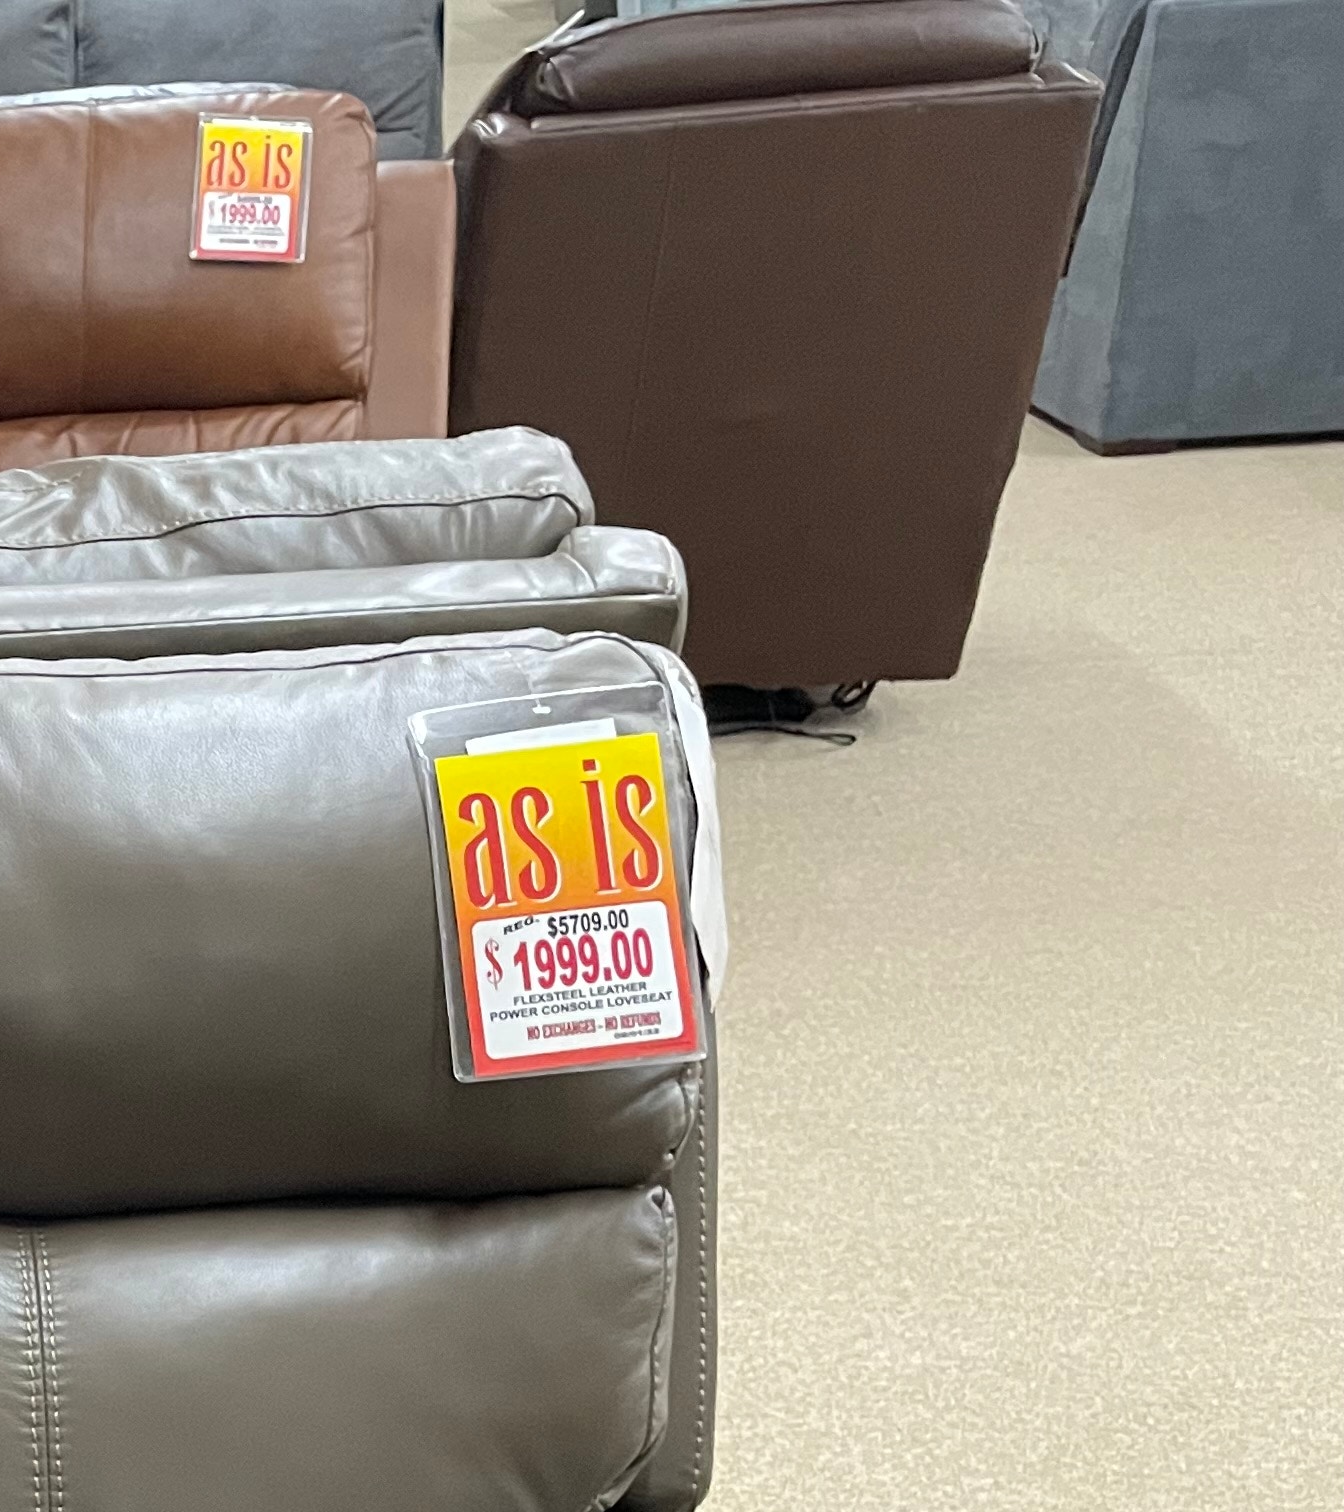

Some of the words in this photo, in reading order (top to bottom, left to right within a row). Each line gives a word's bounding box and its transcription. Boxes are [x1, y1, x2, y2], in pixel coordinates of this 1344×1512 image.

[205, 139, 249, 187] as
[262, 135, 294, 189] is
[220, 203, 281, 226] 1999.00
[458, 785, 563, 910] as
[580, 758, 665, 895] is
[547, 908, 630, 939] $5709.00
[513, 927, 655, 992] 1999.00
[490, 1006, 539, 1022] POWER
[541, 998, 604, 1016] CONSOLE
[607, 990, 673, 1008] LOVESEAT
[513, 989, 587, 1007] FLEXSTEEL
[589, 981, 648, 997] LEATHER
